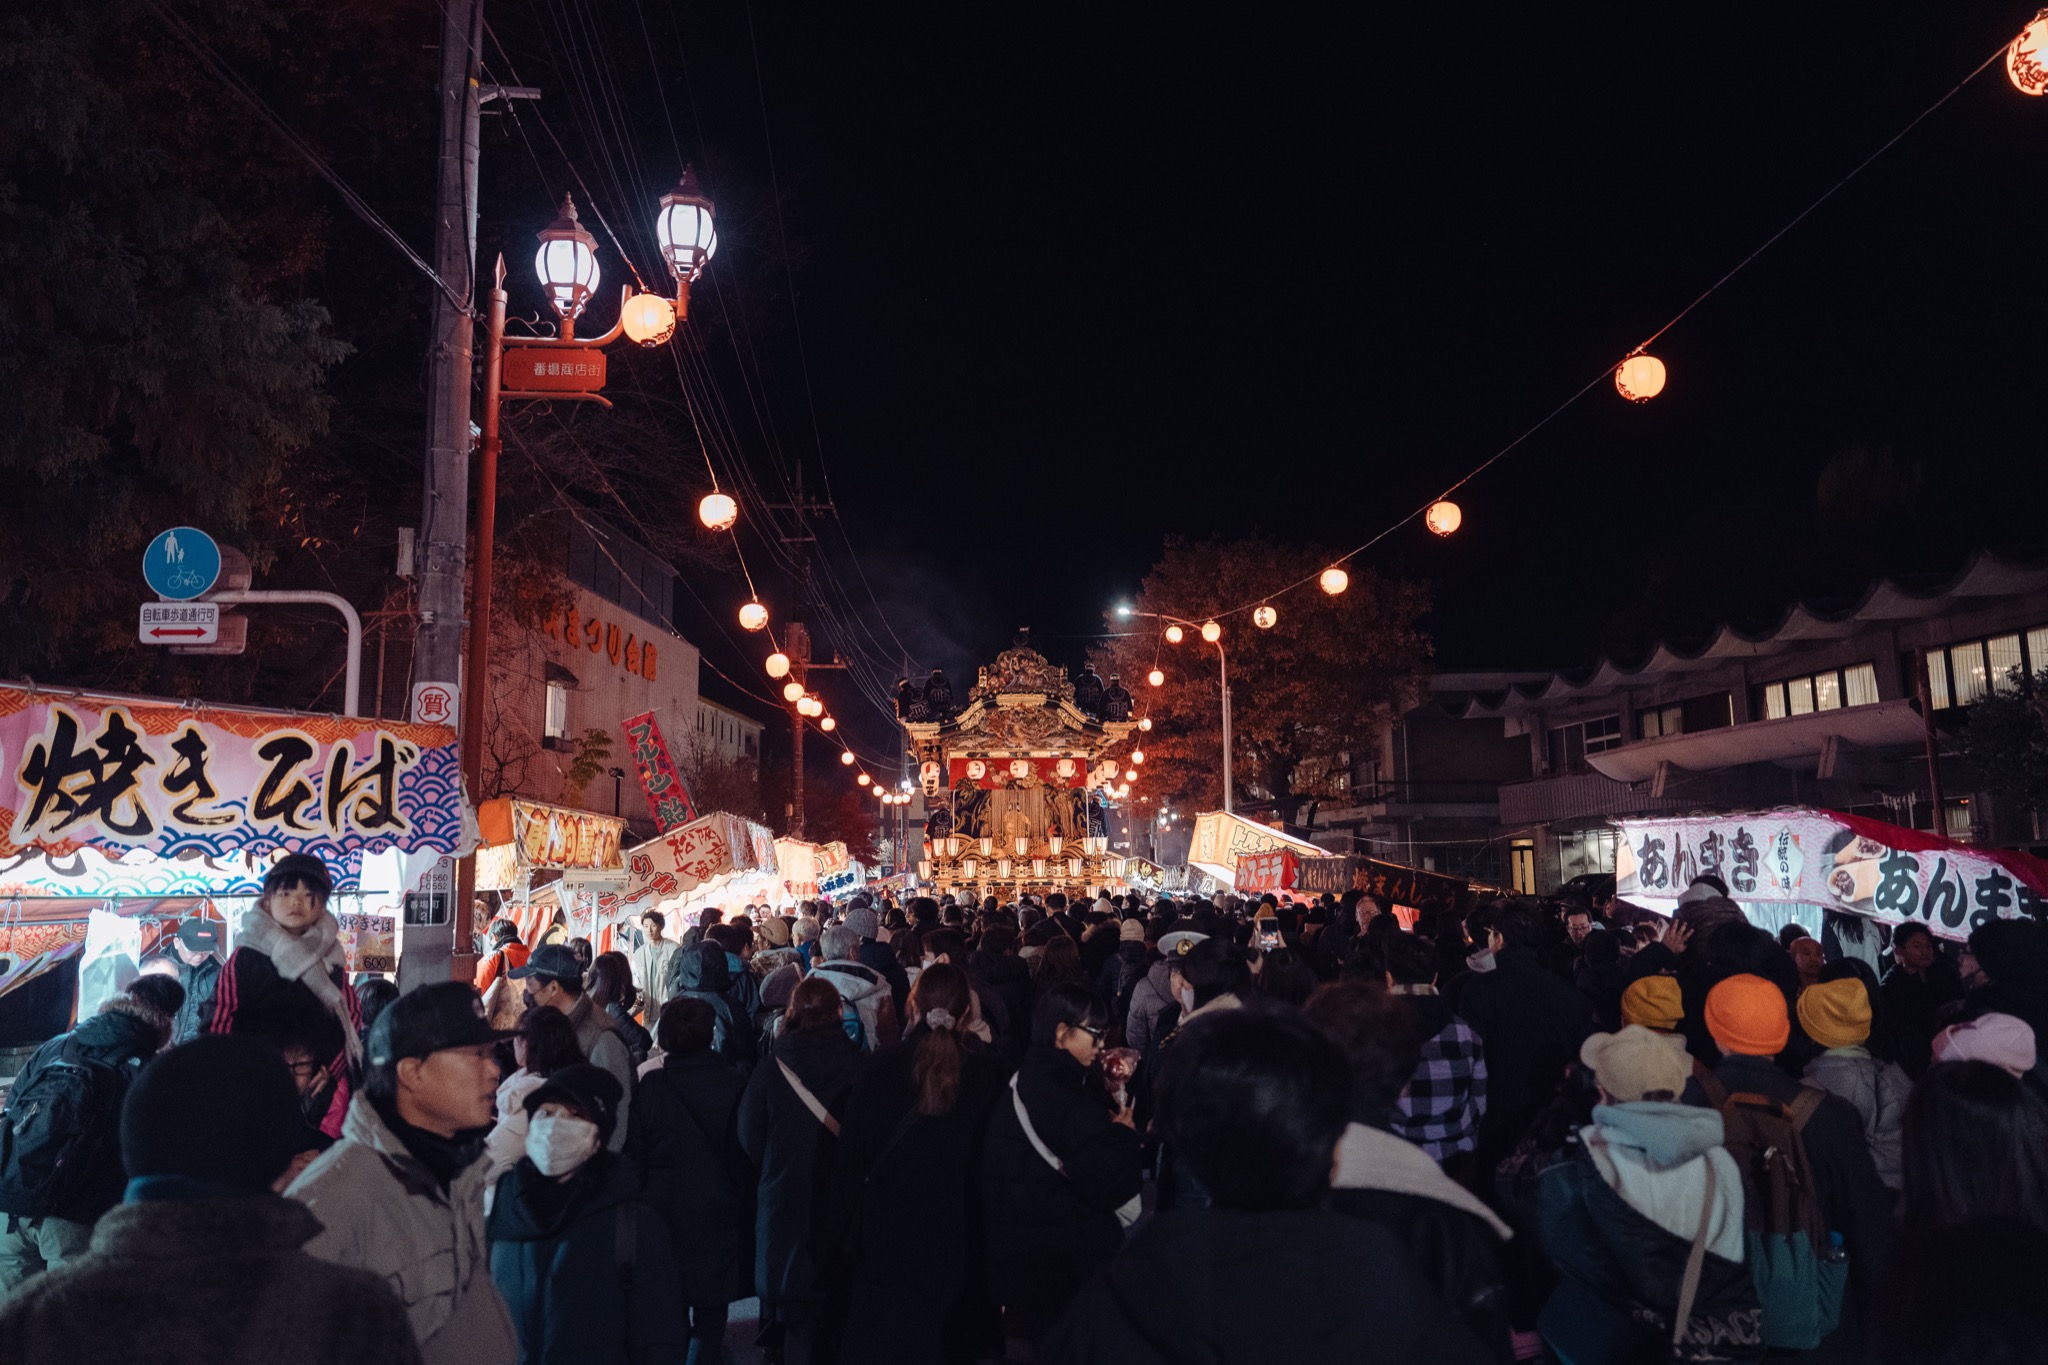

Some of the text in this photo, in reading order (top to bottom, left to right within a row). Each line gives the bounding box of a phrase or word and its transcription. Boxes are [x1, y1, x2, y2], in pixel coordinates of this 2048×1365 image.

[533, 362, 601, 377] 番場商店街
[143, 607, 216, 623] 自転車歩道通行可
[423, 693, 445, 716] 質
[20, 709, 415, 838] 焼きそば
[629, 723, 689, 835] フルーツ飴
[1636, 826, 1760, 893] あんまき
[364, 956, 388, 969] 600
